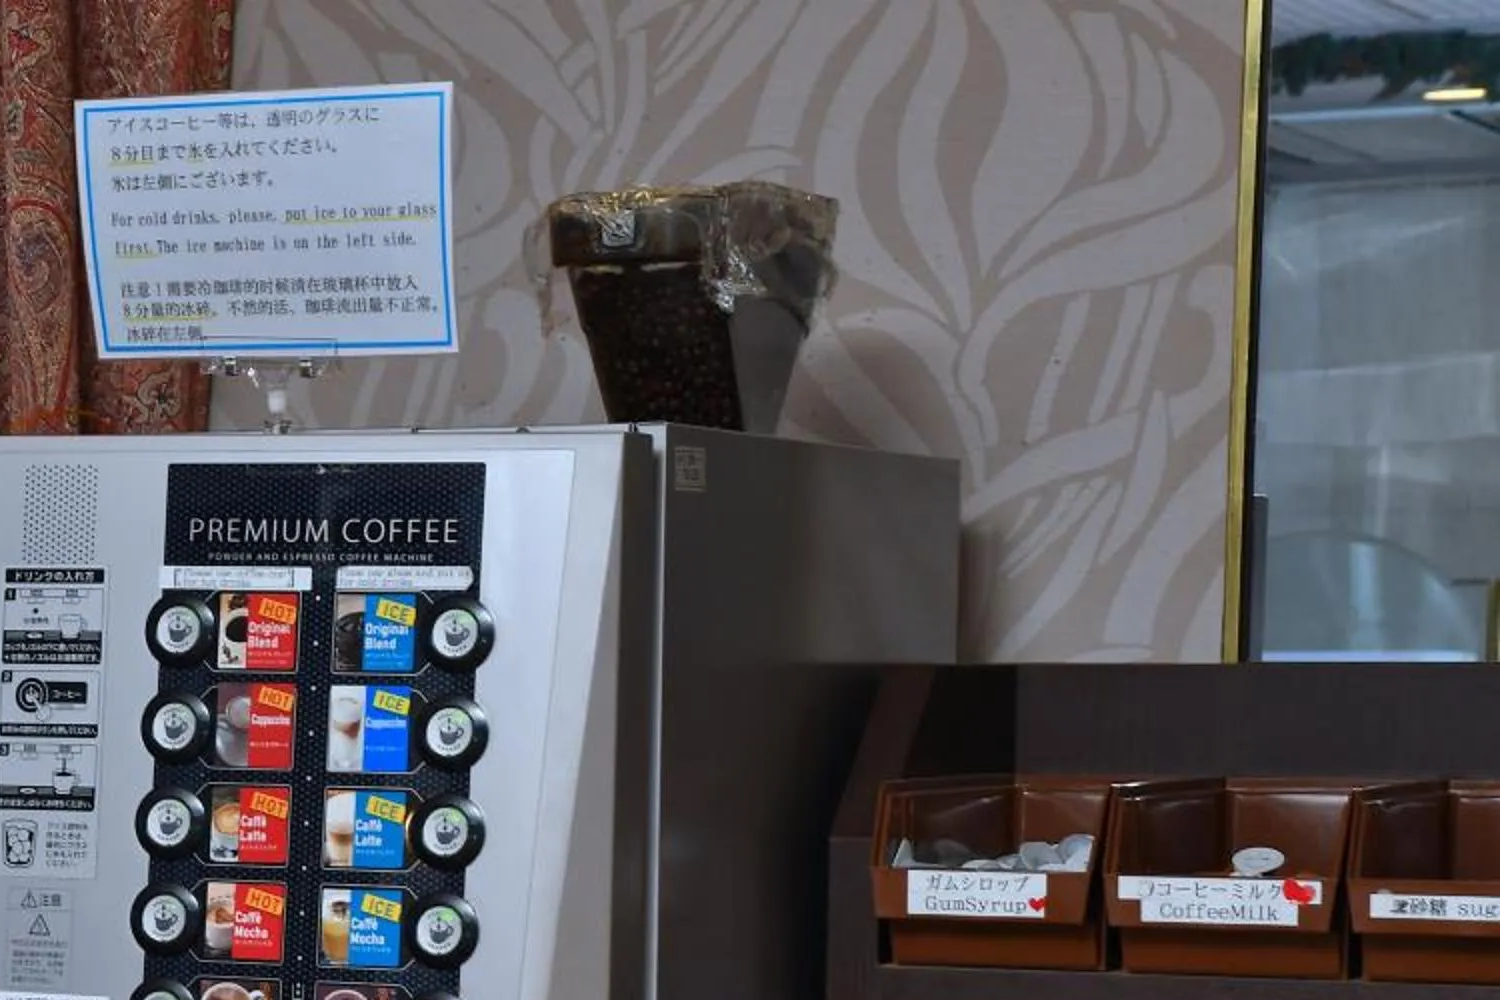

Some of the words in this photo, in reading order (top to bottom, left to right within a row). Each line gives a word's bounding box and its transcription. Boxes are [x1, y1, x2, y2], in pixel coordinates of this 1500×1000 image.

[111, 211, 133, 227] For
[138, 211, 167, 226] cold
[285, 207, 307, 223] put
[314, 205, 336, 219] ice
[363, 204, 392, 218] your
[398, 201, 437, 217] glass
[156, 239, 179, 253] The
[213, 236, 265, 252] machine
[272, 235, 287, 249] is
[293, 238, 309, 249] on
[316, 235, 339, 249] the
[346, 233, 375, 247] left
[189, 518, 330, 543] PREMIUM
[342, 518, 460, 543] COFFEE
[256, 552, 280, 562] AND
[283, 552, 336, 562] ESPRESSO
[339, 553, 379, 562] COFFEE
[383, 553, 434, 563] MACHINE
[262, 601, 295, 620] HOT
[381, 602, 414, 624] ICE
[247, 621, 291, 636] Original
[365, 623, 409, 639] Original
[247, 635, 279, 649] Blend
[365, 638, 397, 650] Blend
[262, 688, 293, 708] HOT
[378, 692, 404, 712] ICE
[255, 794, 287, 815] HOT
[371, 798, 402, 820] ICE
[240, 831, 267, 842] Latte
[355, 835, 382, 847] Latte
[926, 874, 1029, 892] ガムシロップ
[250, 890, 282, 913] HOT
[366, 897, 396, 917] ICE
[925, 895, 1028, 914] GumSyrup
[1159, 902, 1278, 921] CoffeeMilk
[233, 926, 269, 939] Mocha
[349, 932, 385, 945] Mocha
